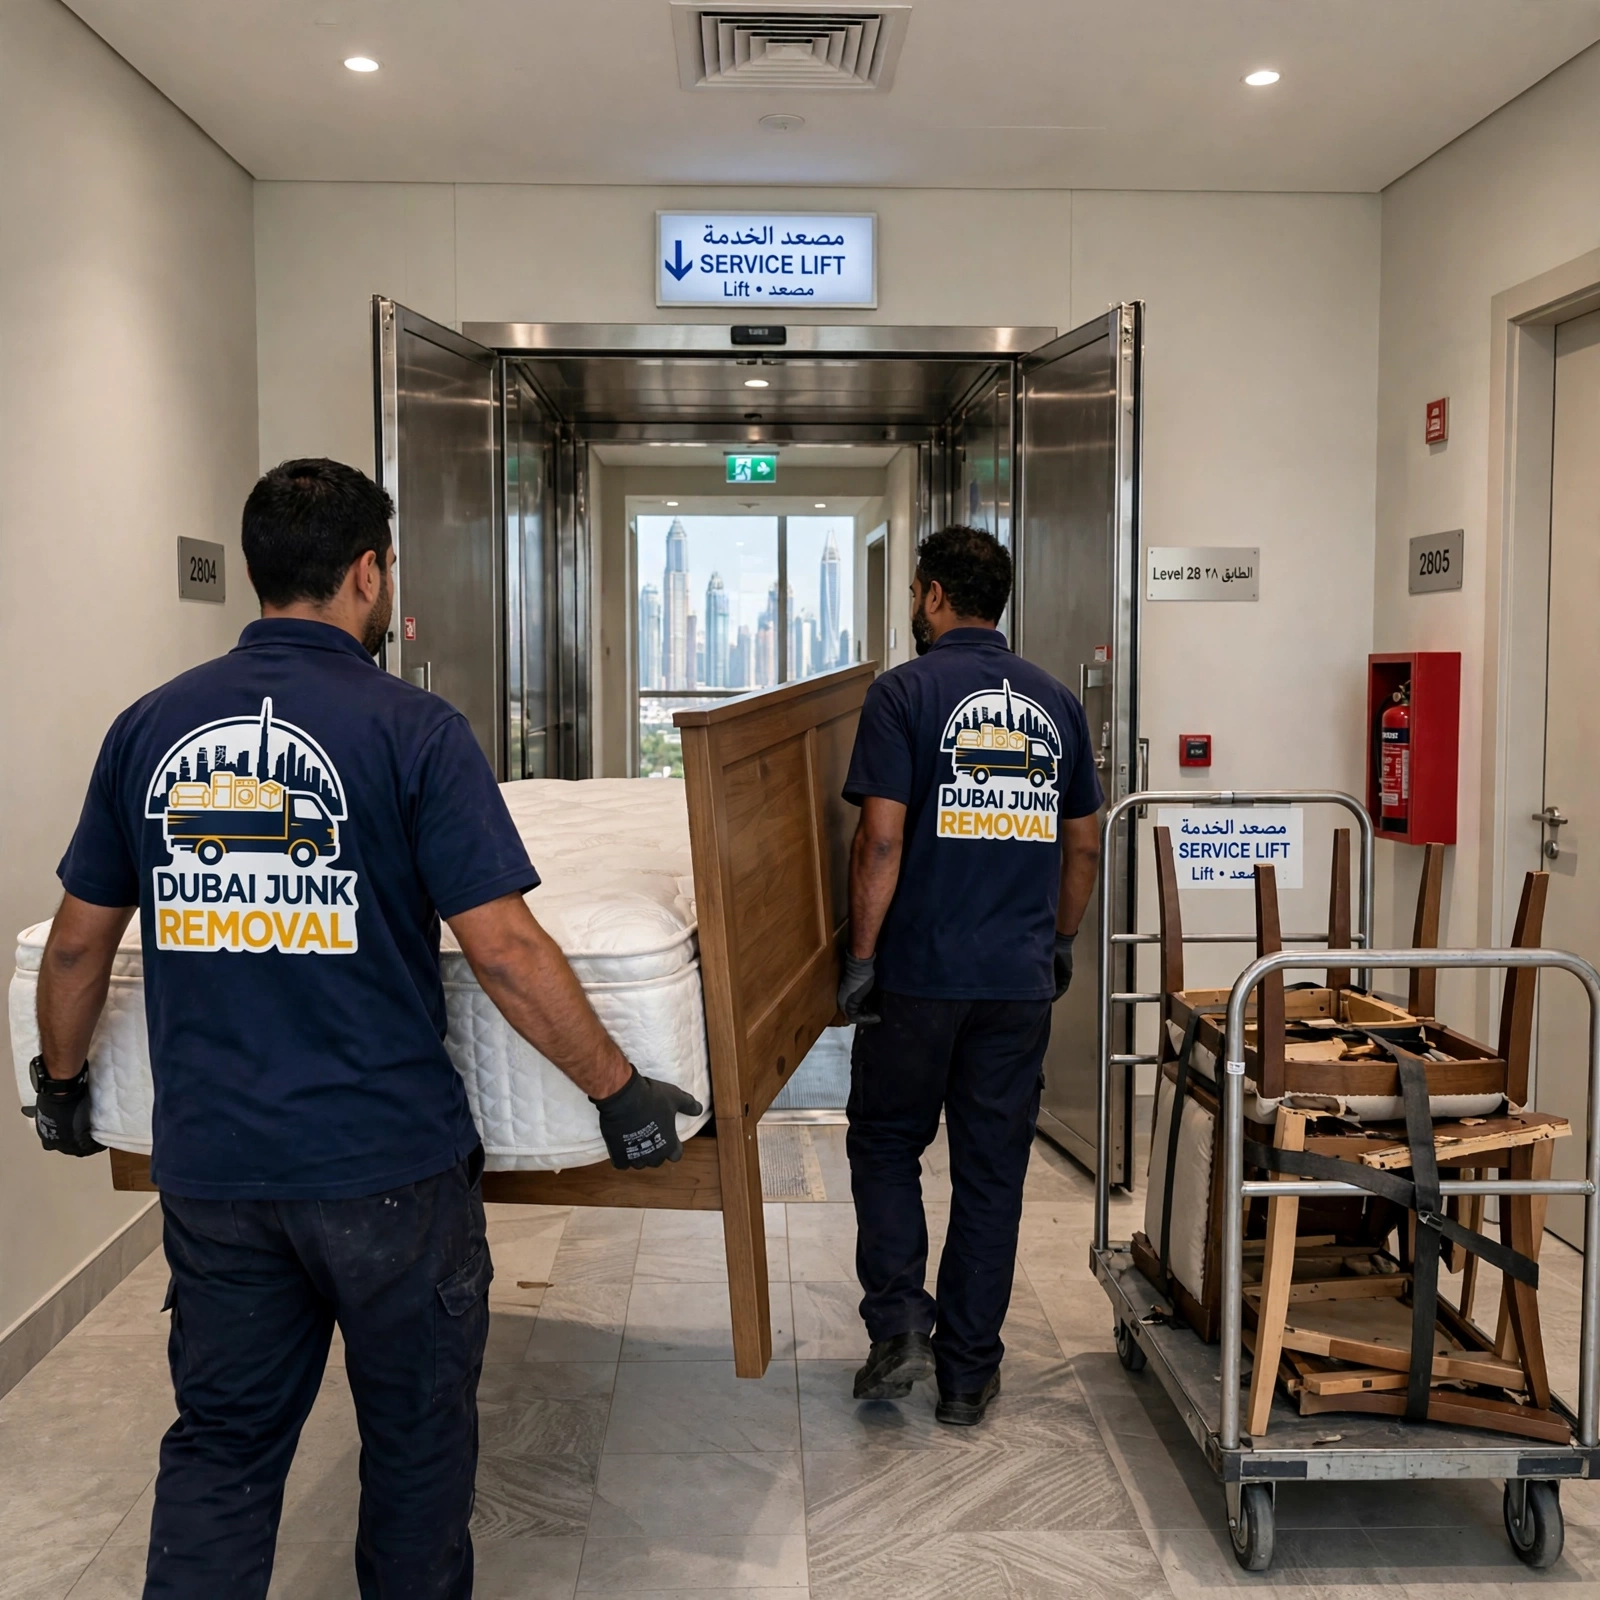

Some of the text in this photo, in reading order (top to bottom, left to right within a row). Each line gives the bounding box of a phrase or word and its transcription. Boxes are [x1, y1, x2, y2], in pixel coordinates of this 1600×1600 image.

[703, 224, 844, 246] مصعد الخدمة
[700, 254, 846, 275] SERVICE LIFT
[723, 281, 814, 297] Lift مصعد
[189, 556, 217, 584] 2804
[1419, 549, 1450, 576] 2805
[1153, 567, 1184, 580] Level
[1186, 566, 1201, 580] 28
[1221, 566, 1253, 583] الطابق
[941, 787, 1057, 812] DUBAI JUNK
[940, 811, 1055, 839] REMOVAL
[1181, 818, 1287, 836] مصعد الخدمة
[1178, 842, 1291, 859] SERVICE LIFT
[1192, 867, 1255, 880] Lift صعد
[157, 872, 353, 906] DUBAI JUNK
[159, 909, 353, 949] REMOVAL
